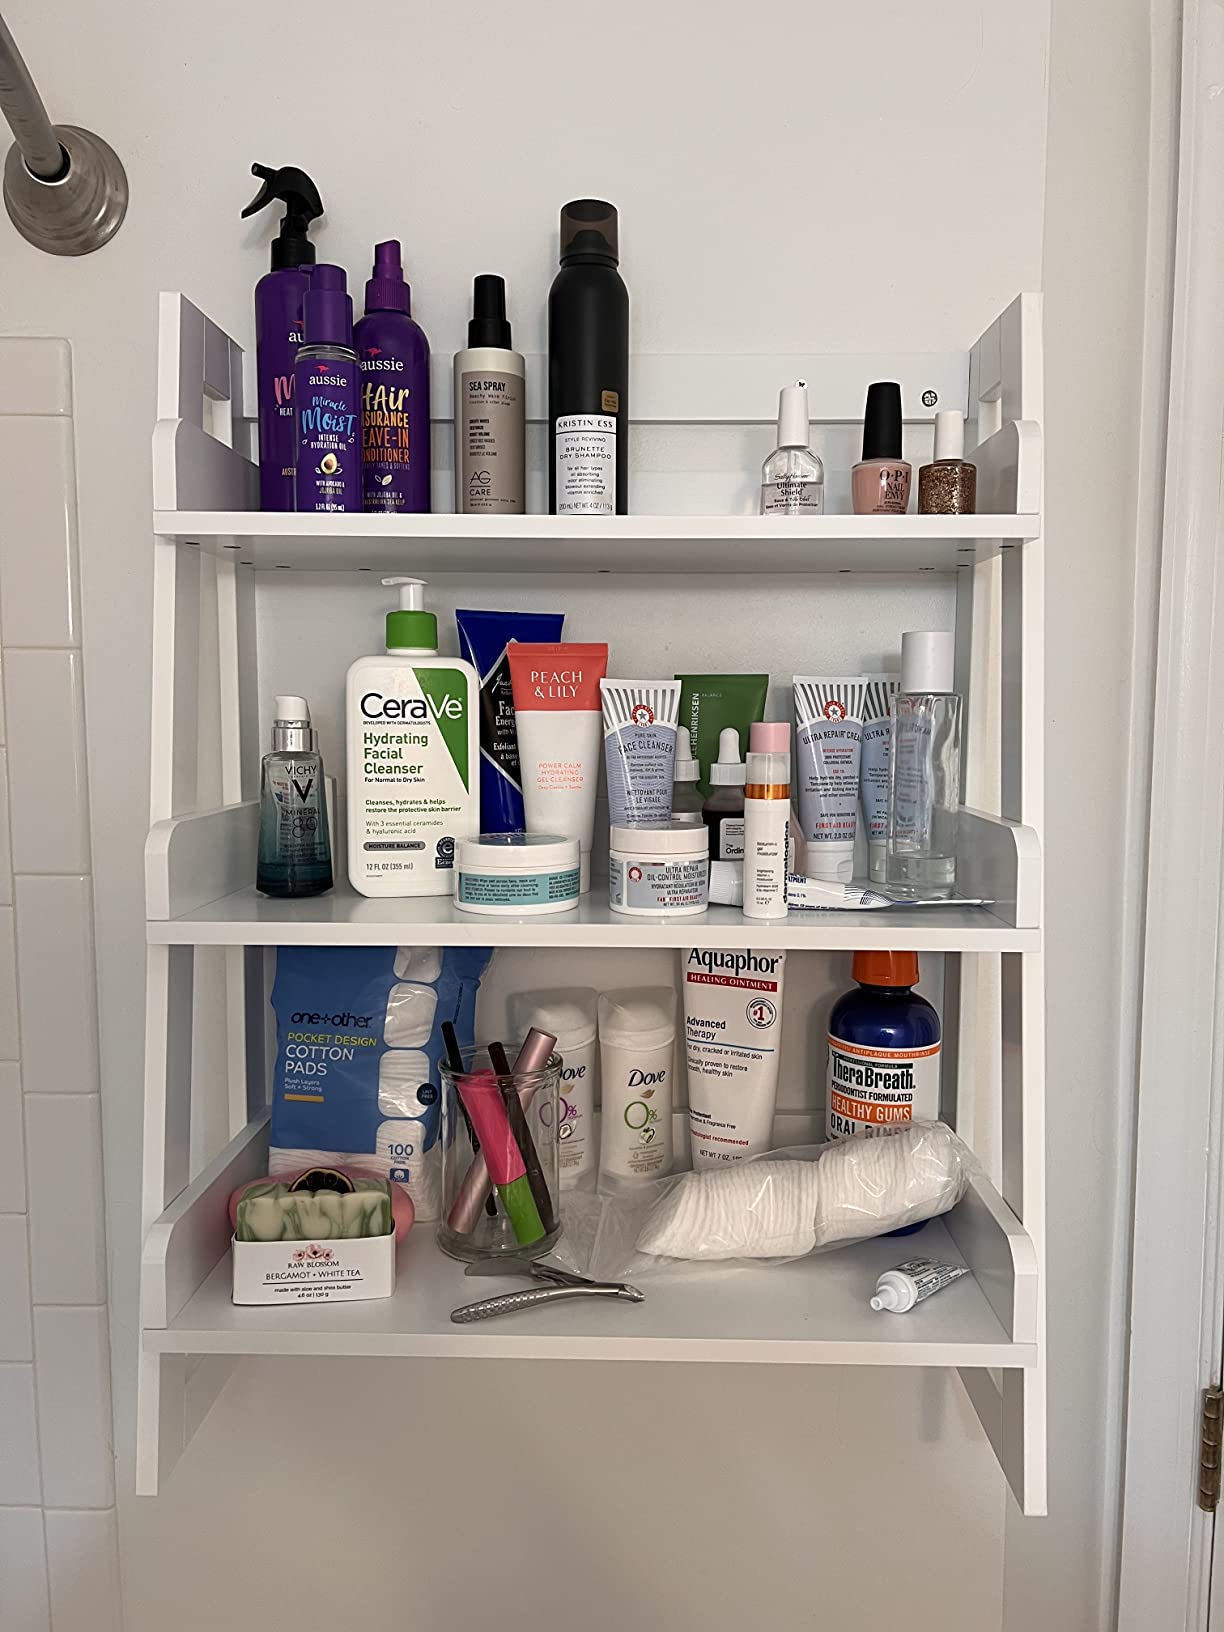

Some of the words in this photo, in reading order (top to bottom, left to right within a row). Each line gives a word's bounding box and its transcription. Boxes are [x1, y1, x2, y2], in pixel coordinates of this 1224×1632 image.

[360, 357, 404, 371] aussie
[309, 375, 347, 386] aussie
[469, 381, 482, 391] SEA
[484, 381, 506, 392] SPRAY
[312, 395, 347, 411] Miracle
[279, 407, 293, 416] HEAT
[363, 411, 409, 428] SURANCE
[558, 420, 593, 428] KRISTIN
[597, 420, 613, 428] ESS
[319, 434, 339, 442] INTENSE
[363, 428, 409, 448] EAVE-IN
[311, 442, 338, 450] HYDRATION
[364, 448, 410, 463] NDITIONER
[469, 470, 491, 484] AG
[776, 482, 807, 490] Ultimate
[886, 483, 905, 492] NAIL
[884, 490, 904, 500] ENVY
[531, 671, 582, 683] PEACH
[534, 685, 545, 698] &
[549, 685, 578, 698] LILY
[360, 692, 463, 719] CeraVe
[498, 701, 515, 716] Fac
[363, 732, 428, 747] Hydrating
[802, 732, 823, 745] ULTRA
[823, 730, 846, 739] REPAIR
[846, 732, 861, 743] CREA
[864, 729, 884, 741] ULTRA
[364, 748, 403, 759] Facial
[638, 740, 673, 755] CLEANSER
[285, 765, 317, 775] VICHY
[364, 762, 424, 774] Cleanser
[286, 808, 321, 816] MINERAL
[292, 817, 318, 838] 89
[390, 862, 402, 870] (355
[665, 866, 682, 874] ULTRA
[646, 873, 682, 881] OIL-CONTROL
[788, 875, 807, 884] ATMENT
[687, 948, 779, 976] Aquaphor
[690, 974, 727, 984] HEALING
[729, 978, 773, 990] OINTMENT
[753, 1006, 764, 1021] #1
[291, 1012, 373, 1029] one+other
[686, 1016, 726, 1030] Advanced
[287, 1032, 332, 1044] POCKET
[334, 1035, 377, 1047] DESIGN
[687, 1027, 716, 1040] Therapy
[285, 1045, 354, 1061] COTTON
[702, 1046, 723, 1055] cracked
[730, 1049, 750, 1059] irritated
[751, 1052, 763, 1060] skin
[852, 1048, 890, 1058] ANTIPLAQUE
[894, 1050, 930, 1058] MOUTHRINSE
[285, 1061, 327, 1076] PADS
[704, 1060, 722, 1068] proven
[729, 1064, 748, 1072] restore
[628, 1069, 666, 1087] Dove
[702, 1067, 721, 1077] healthy
[722, 1070, 733, 1078] skin
[832, 1080, 868, 1100] PERIODONTIST
[868, 1091, 913, 1102] FORMULATED
[832, 1094, 873, 1120] HEALTHY
[876, 1106, 911, 1121] GUMS
[624, 1101, 658, 1129] 0%
[712, 1134, 749, 1146] recommended
[387, 1144, 413, 1156] 100
[700, 1149, 708, 1157] NET
[307, 1260, 340, 1268] BLOSSOM
[266, 1272, 310, 1280] BERGAMOT
[318, 1270, 345, 1278] WHITE
